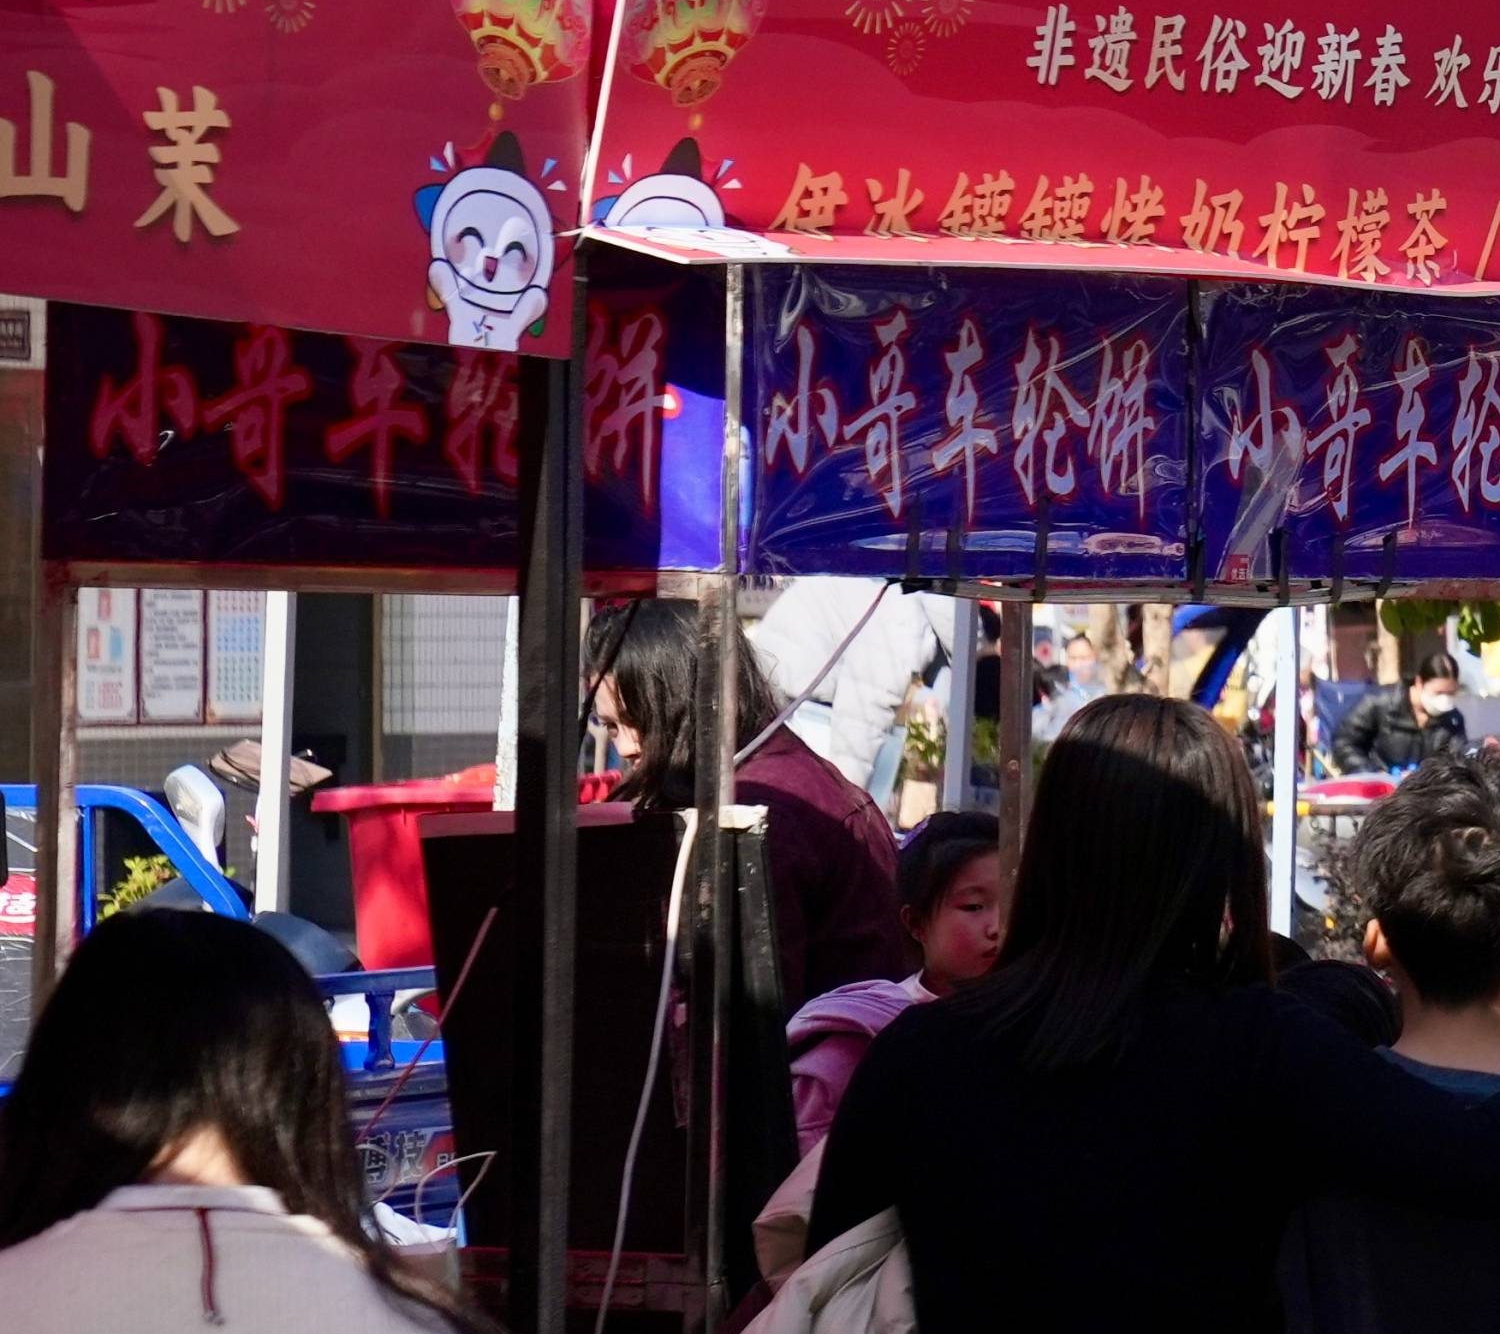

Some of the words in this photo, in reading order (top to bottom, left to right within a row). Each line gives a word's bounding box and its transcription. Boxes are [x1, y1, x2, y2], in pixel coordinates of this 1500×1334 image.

[1026, 3, 1411, 106] 非遗民俗迎新春
[766, 308, 1155, 525] 小哥车轮饼
